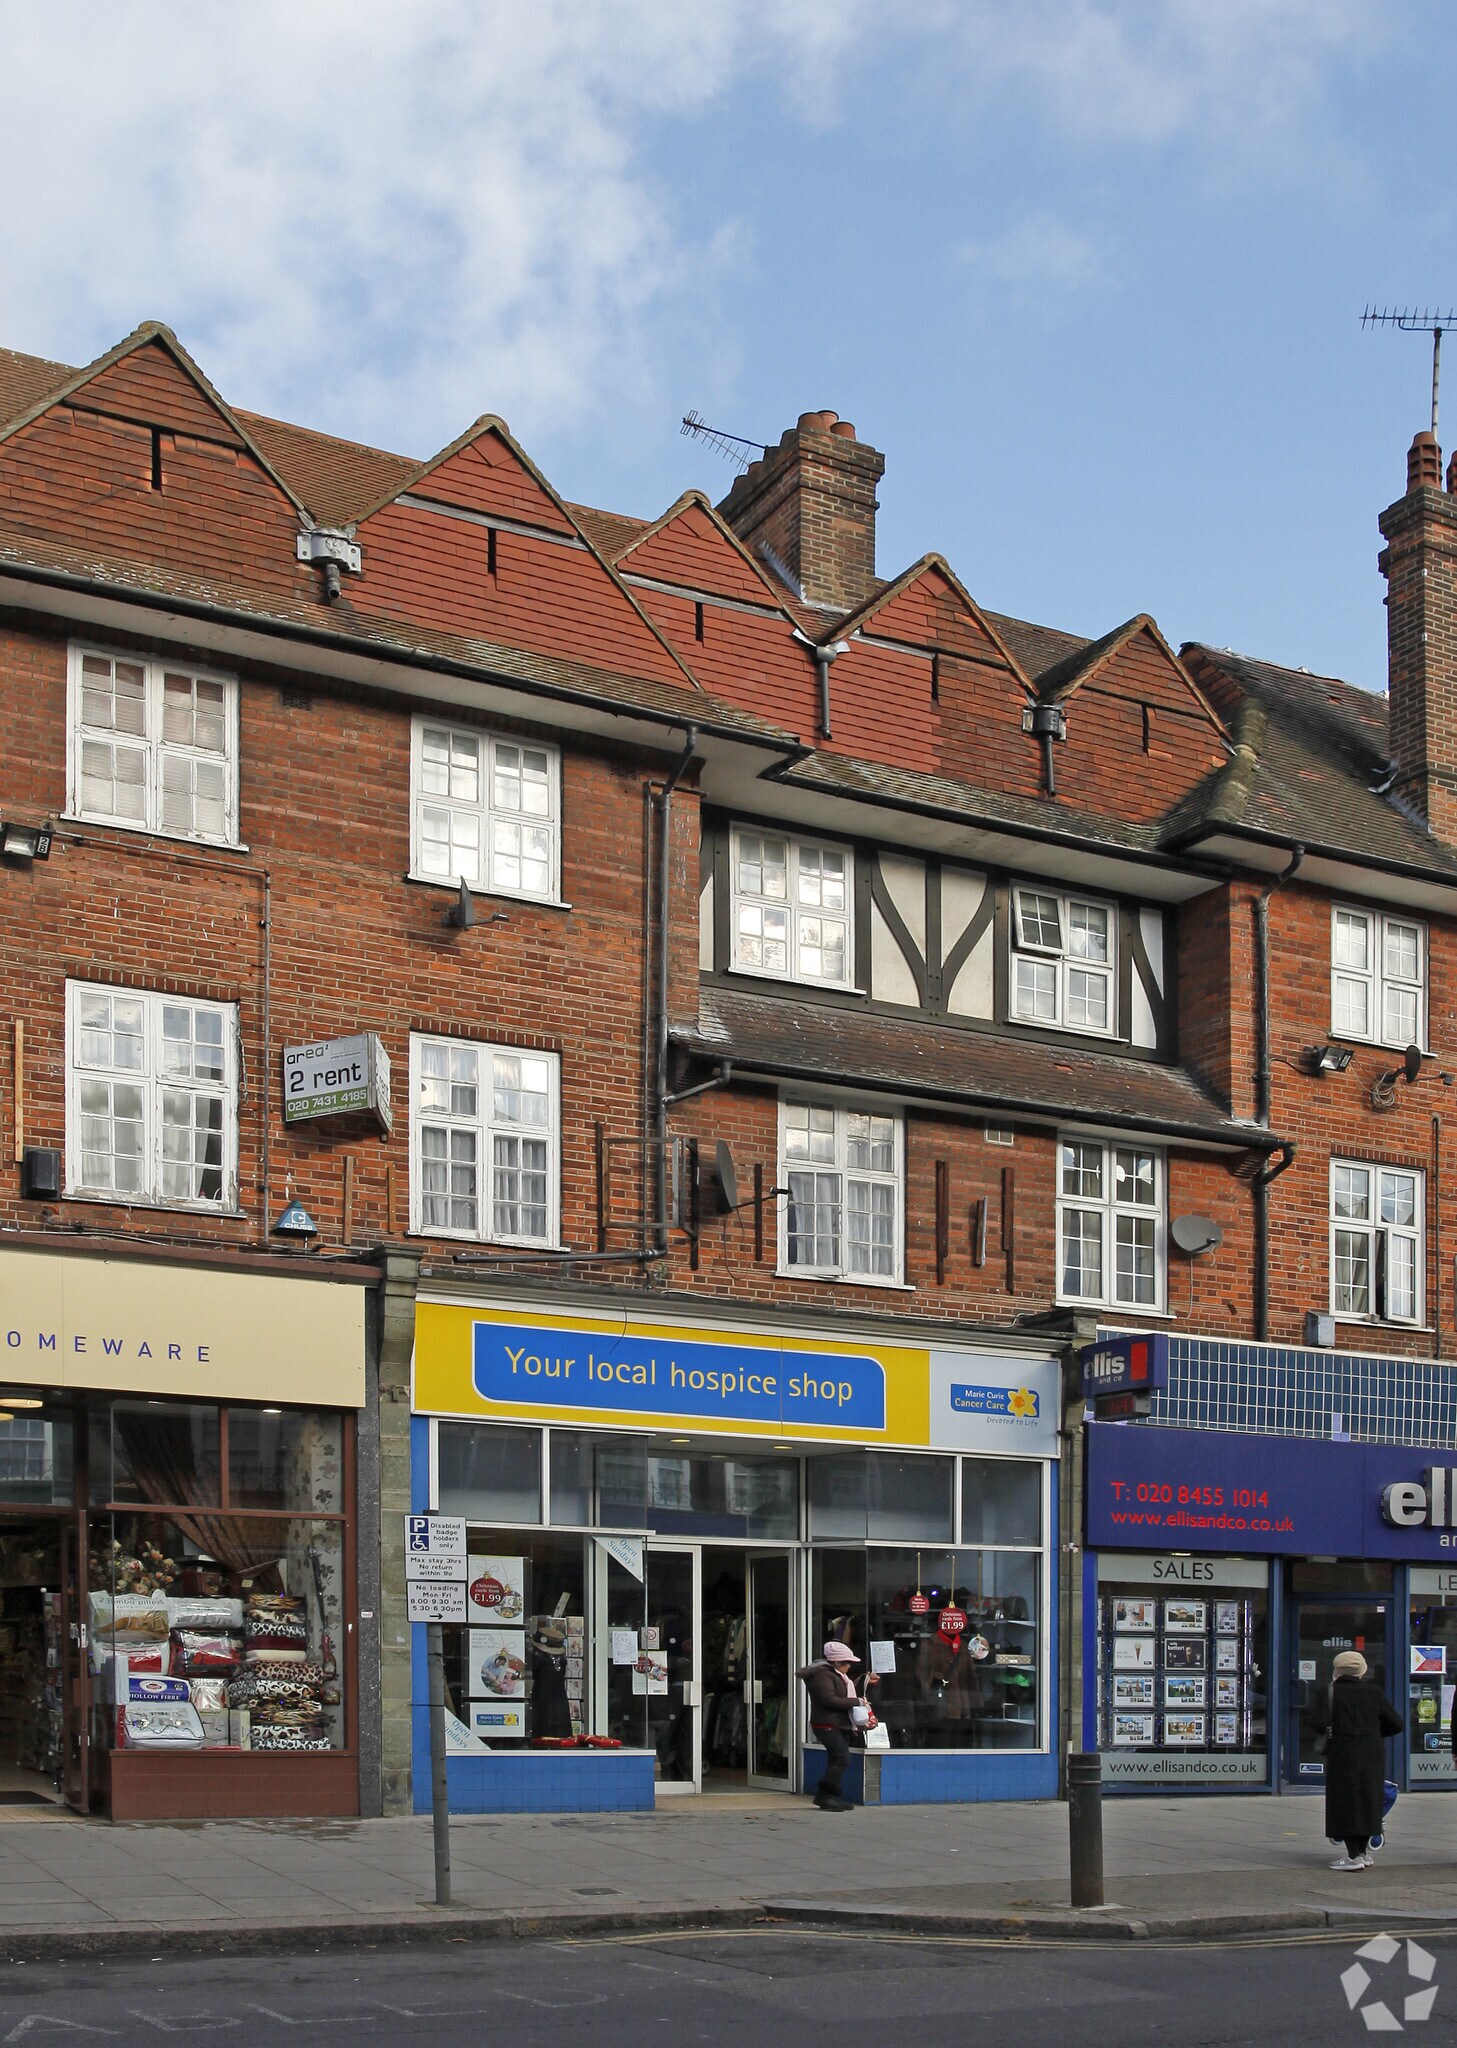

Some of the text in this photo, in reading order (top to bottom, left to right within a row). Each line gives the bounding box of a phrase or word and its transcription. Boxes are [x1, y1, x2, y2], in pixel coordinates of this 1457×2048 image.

[290, 1062, 362, 1093] 2 rent
[287, 1089, 367, 1112] 020 7431 4185
[284, 1222, 313, 1231] CHUBB
[504, 1346, 853, 1407] Your local hospice shop
[1099, 1375, 1112, 1385] and
[965, 1389, 1005, 1400] Marie Curie
[954, 1398, 1005, 1410] Cancer Care
[986, 1416, 1015, 1426] Devoted
[1025, 1420, 1039, 1428] Life
[1110, 1481, 1269, 1508] T: 020 8455 1014
[430, 1522, 461, 1530] Disabled
[1110, 1510, 1295, 1532] www.ellisandco.co.uk
[608, 1540, 635, 1568] Sundays
[620, 1539, 638, 1557] Open
[1152, 1560, 1215, 1581] SALES
[474, 1593, 501, 1603] £1.99
[941, 1621, 964, 1630] £1.99
[1322, 1636, 1352, 1648] ellis
[160, 1693, 181, 1701] FIBRE
[452, 1720, 470, 1738] Open
[445, 1725, 467, 1748] undays
[1109, 1760, 1258, 1774] www.ellisandco.co.uk
